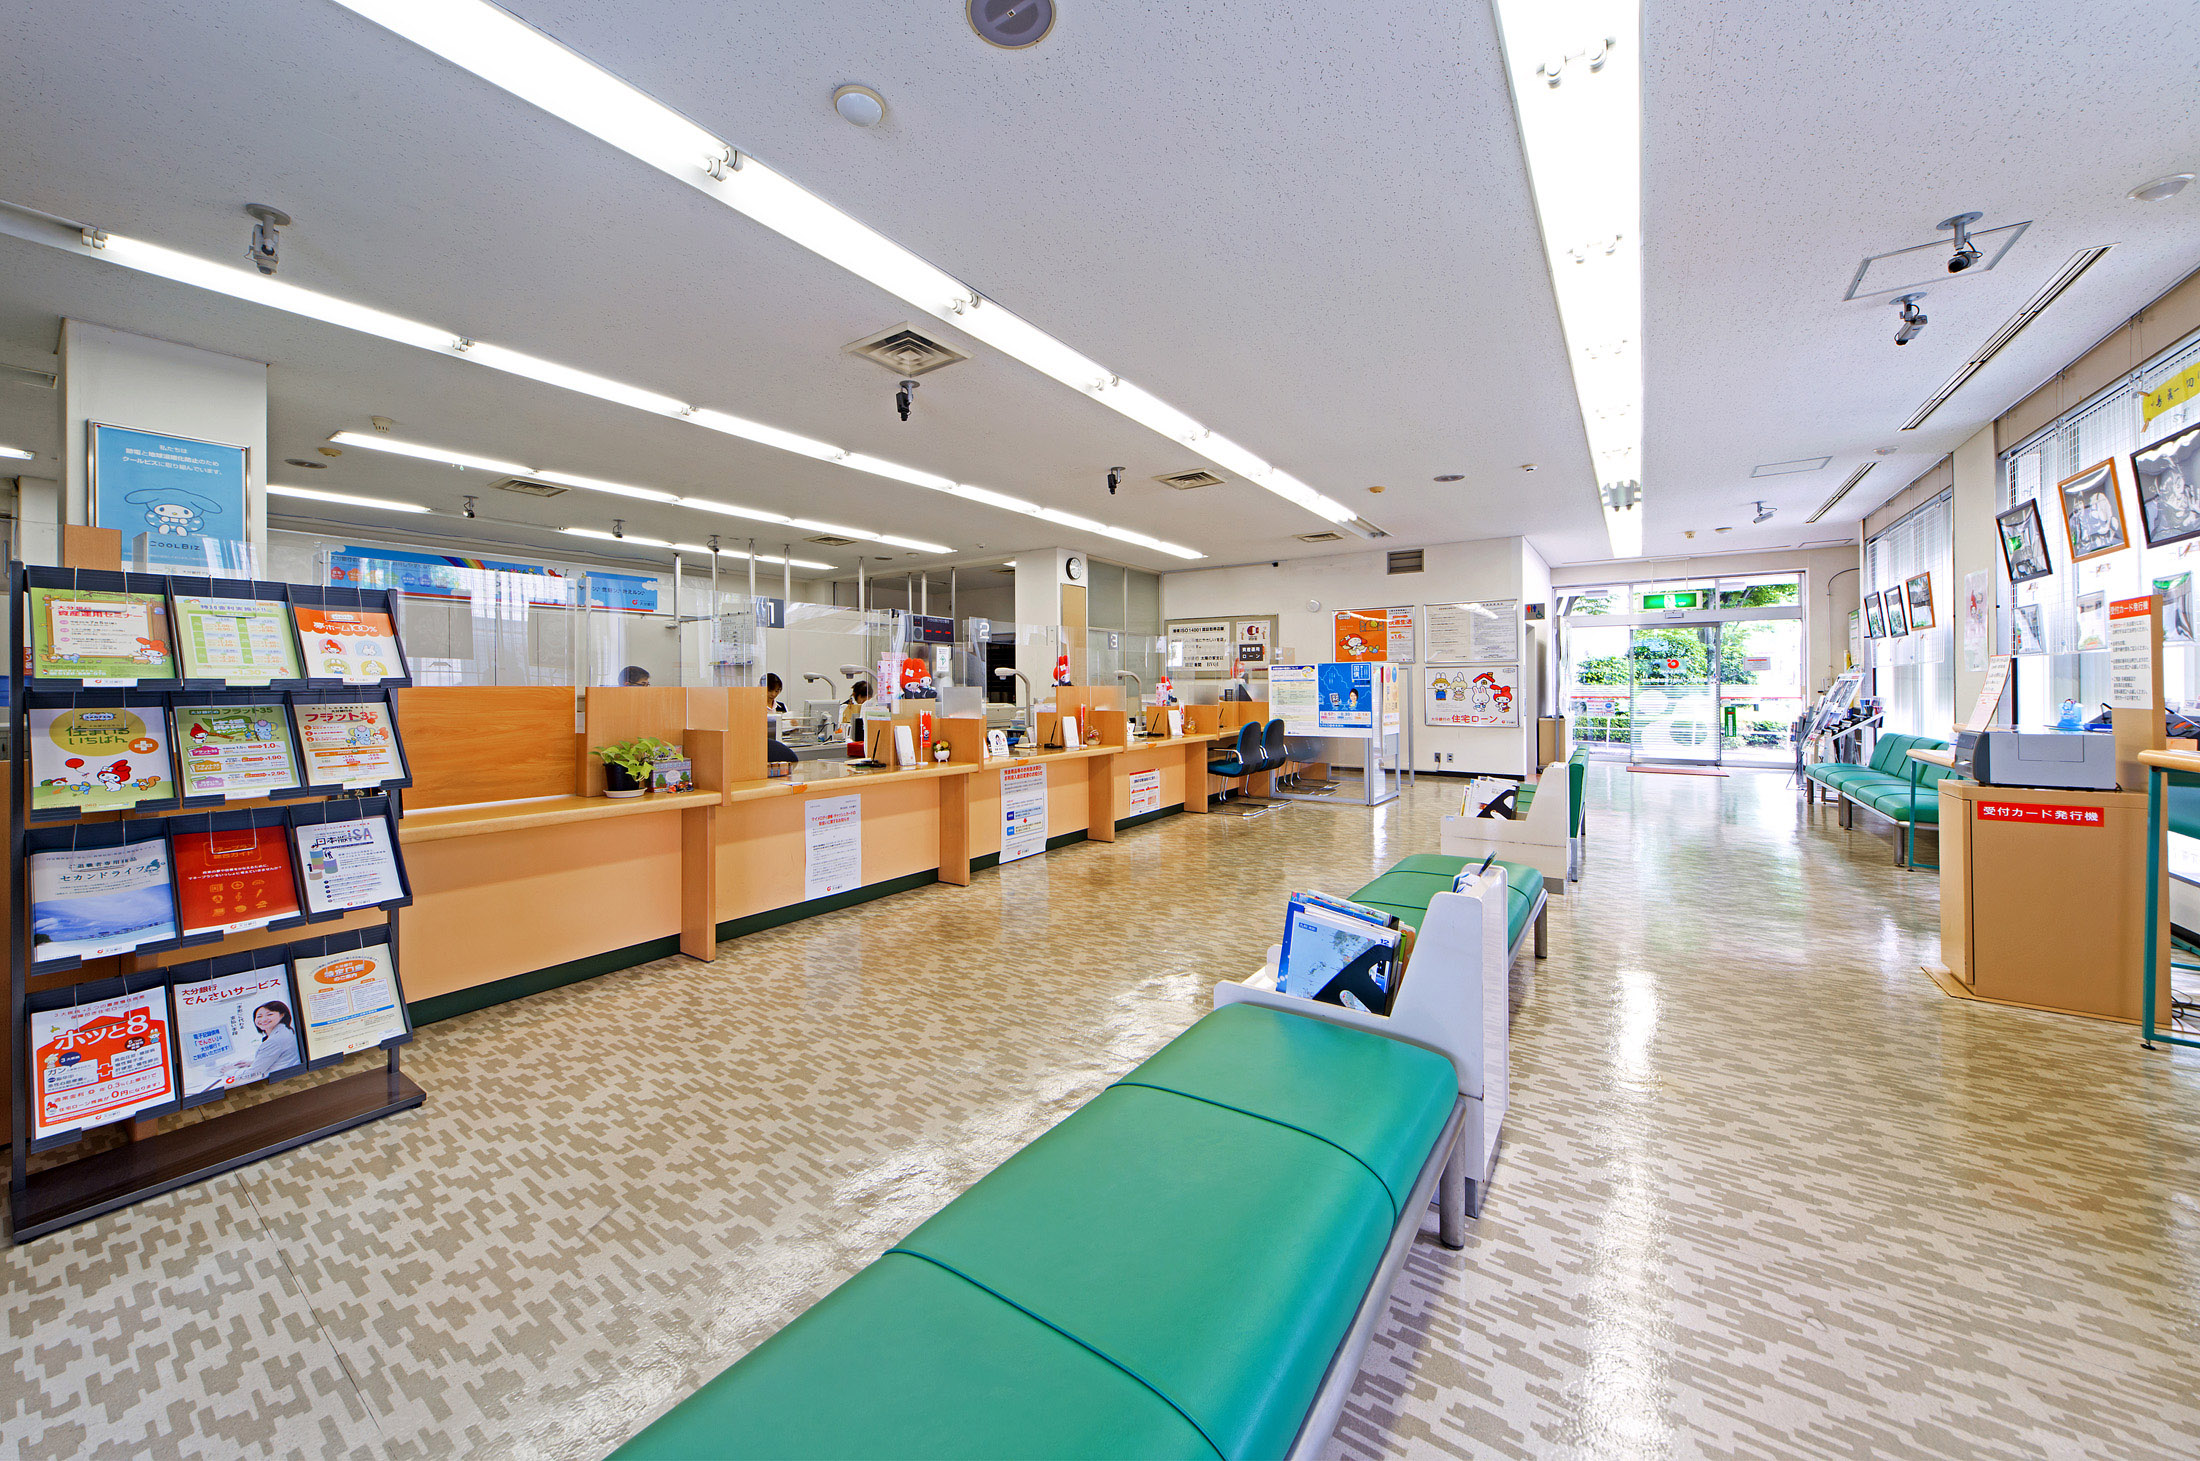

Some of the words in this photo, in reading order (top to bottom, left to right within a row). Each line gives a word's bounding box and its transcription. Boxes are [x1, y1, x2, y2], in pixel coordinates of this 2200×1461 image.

[159, 444, 187, 454] 私たちは
[125, 447, 220, 467] 節電と地球温暖化防止のため
[122, 456, 223, 475] クールビズに取り組んでいます。
[58, 610, 143, 618] 資産運用セミナー
[766, 602, 775, 624] 1
[2110, 600, 2149, 616] 受付カード発行機
[979, 622, 990, 640] 2
[1110, 633, 1118, 648] 3
[222, 707, 274, 715] フラット35
[304, 711, 378, 722] フラット35
[1451, 714, 1498, 723] 住宅ローン
[65, 725, 130, 737] 住まいる
[68, 735, 128, 745] いちばん
[1983, 806, 2099, 821] 受付カード発行機
[60, 865, 146, 882] セカンドライフ
[181, 984, 217, 996] 大分銀行
[182, 978, 281, 1006] でんさいサービス
[54, 1014, 149, 1051] ホッと8
